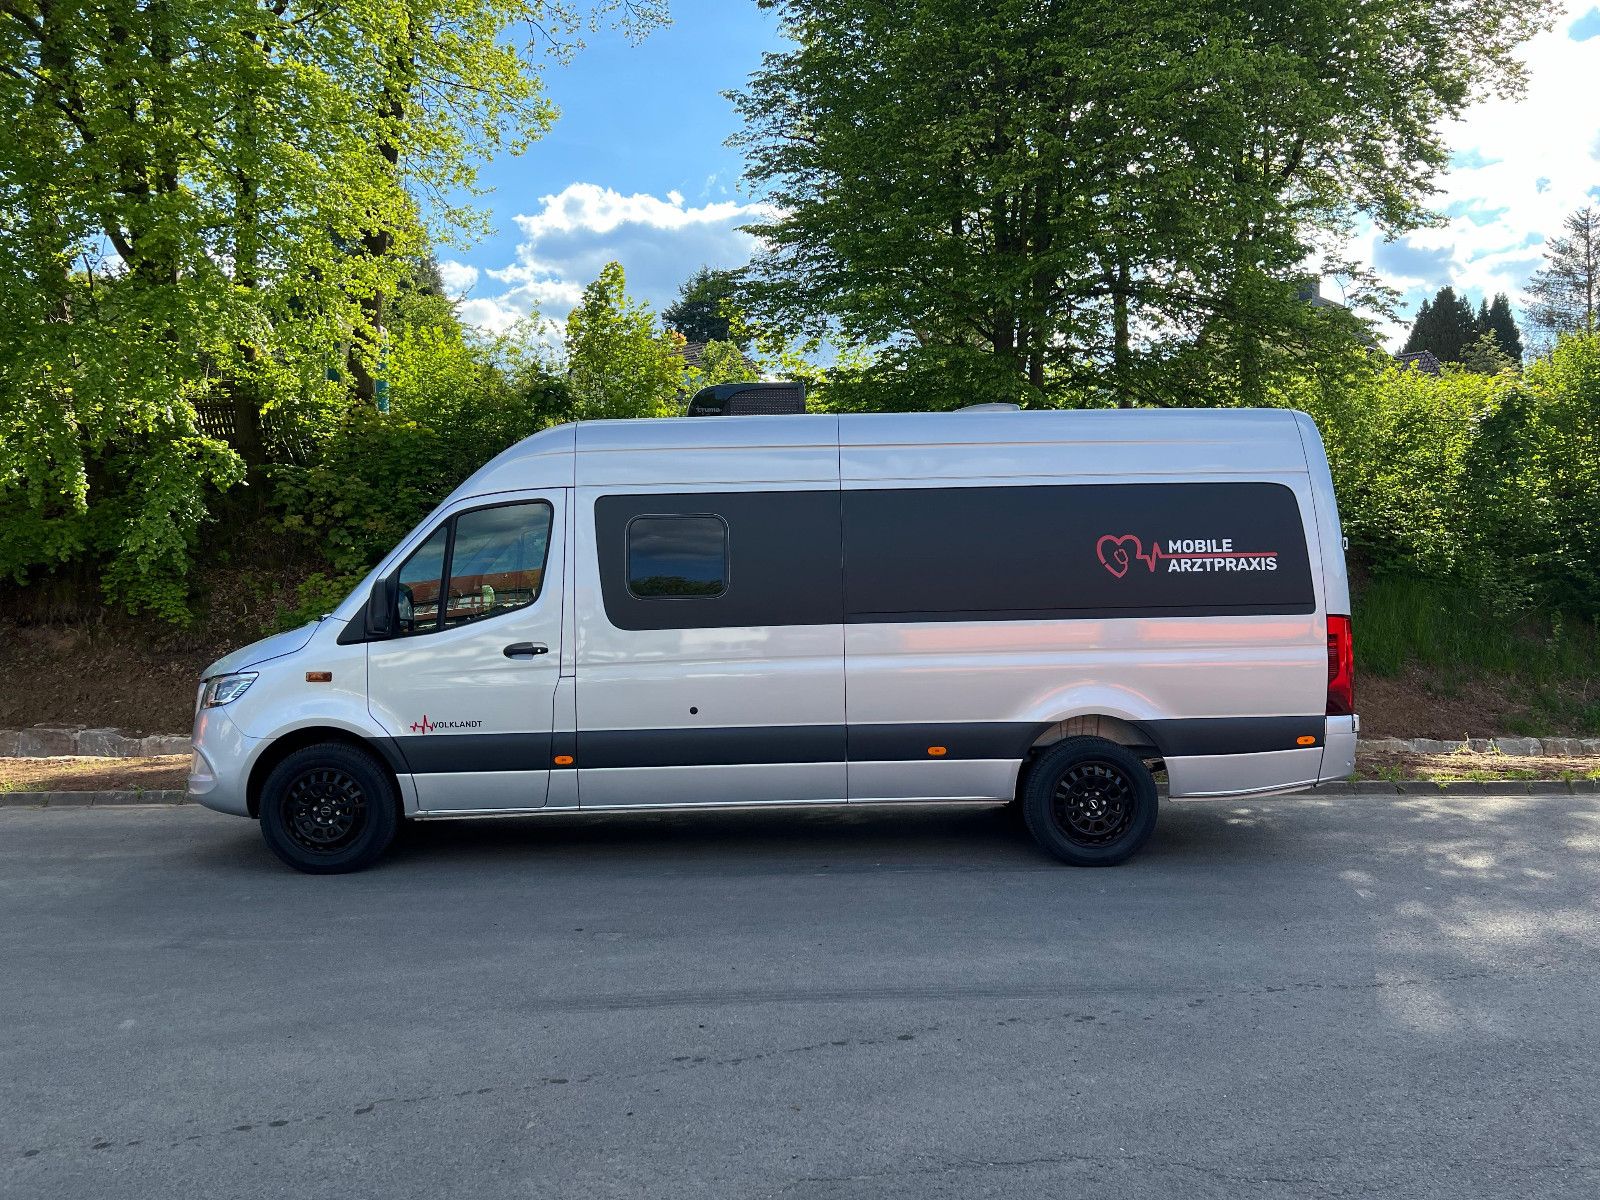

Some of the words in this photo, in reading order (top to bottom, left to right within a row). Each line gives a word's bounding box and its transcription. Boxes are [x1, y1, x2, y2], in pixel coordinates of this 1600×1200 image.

[1168, 539, 1233, 553] MOBILE
[1168, 557, 1278, 572] ARZTPRAXIS
[432, 720, 482, 729] VOLKLANDT
